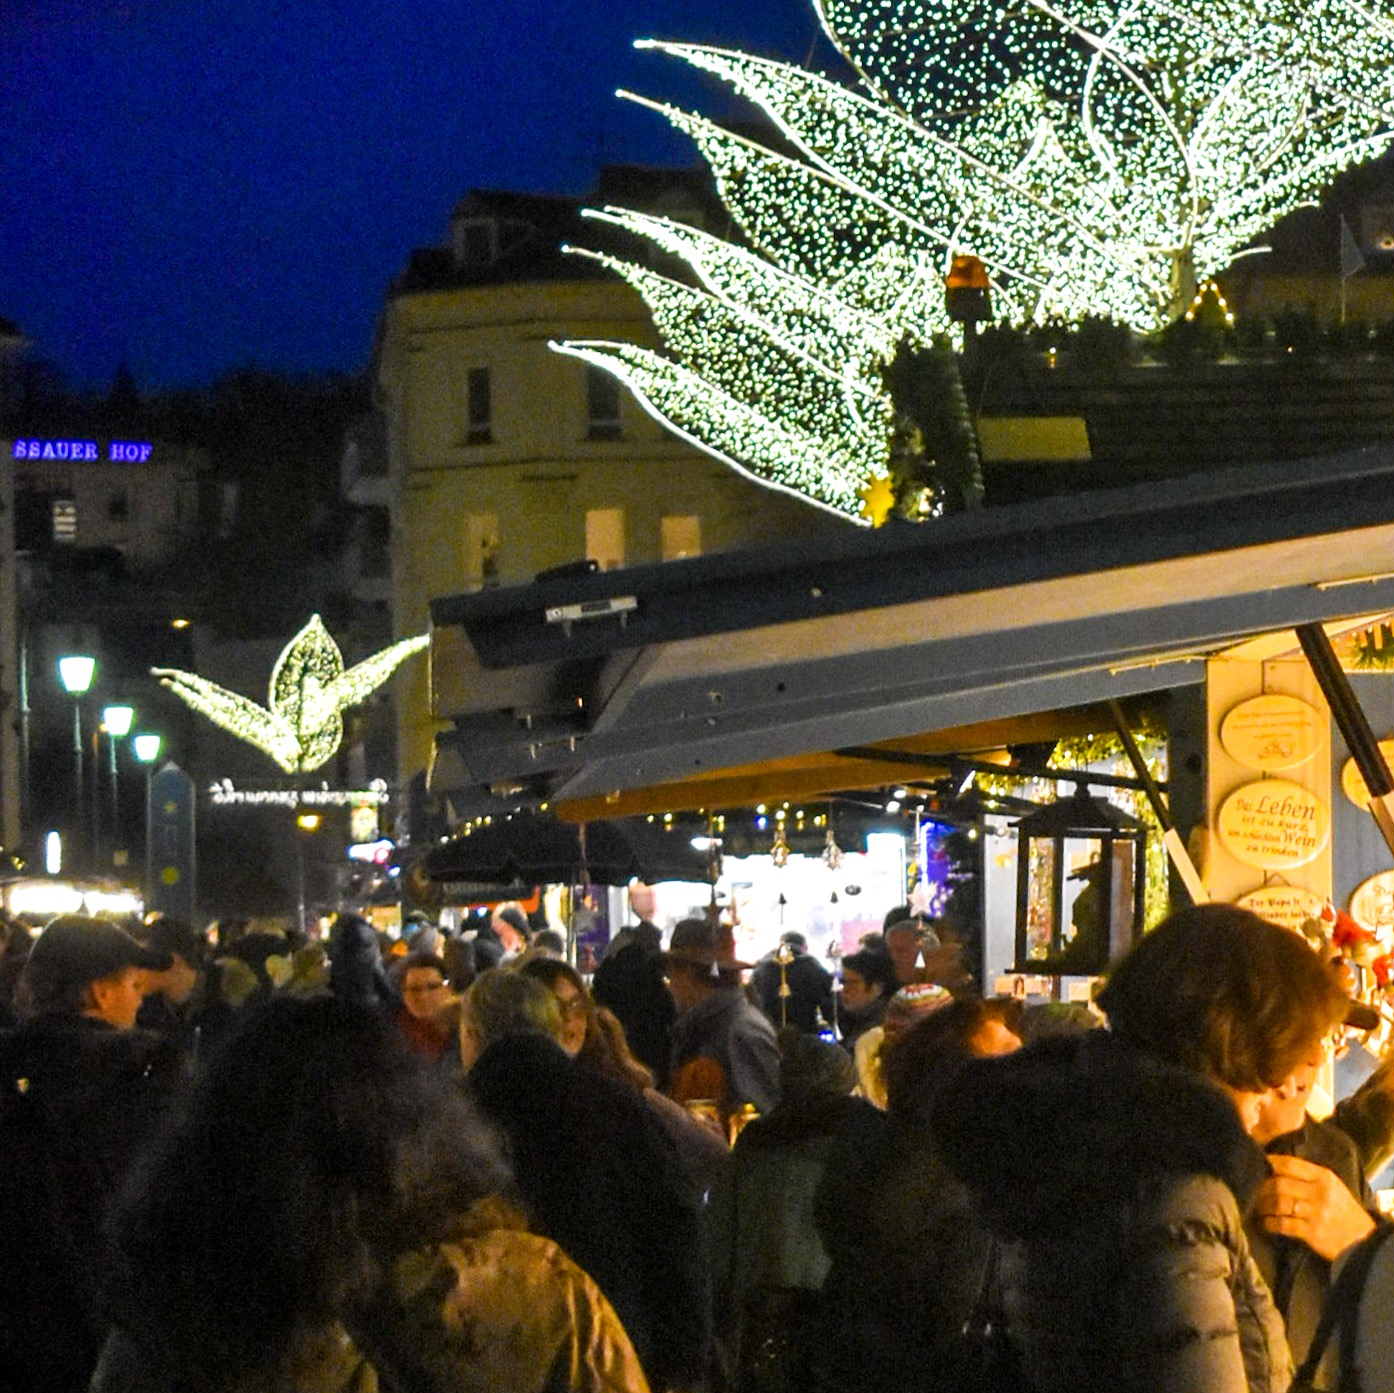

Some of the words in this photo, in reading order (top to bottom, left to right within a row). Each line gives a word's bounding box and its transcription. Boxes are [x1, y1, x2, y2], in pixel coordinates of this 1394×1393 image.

[14, 439, 98, 461] SSAUER
[109, 441, 153, 463] HOF
[1255, 795, 1316, 820] Leben
[1259, 818, 1274, 827] zu
[1282, 828, 1316, 847] Wein
[1246, 844, 1258, 853] zu
[1261, 845, 1299, 857] trinken
